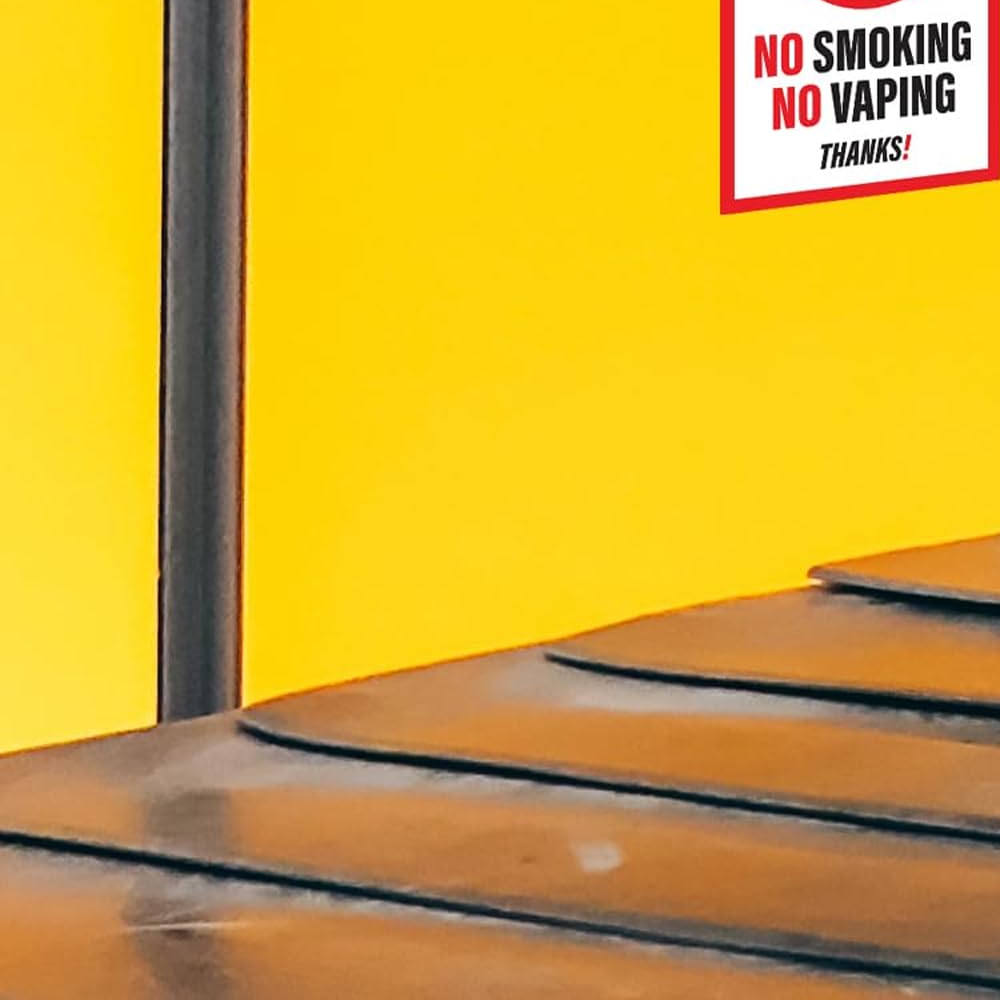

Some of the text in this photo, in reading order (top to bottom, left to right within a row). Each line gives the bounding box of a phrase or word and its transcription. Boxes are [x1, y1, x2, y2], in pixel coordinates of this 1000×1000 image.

[754, 20, 972, 79] NO SMOKING
[772, 72, 956, 131] NO VAPING
[820, 134, 912, 170] THANKS!
